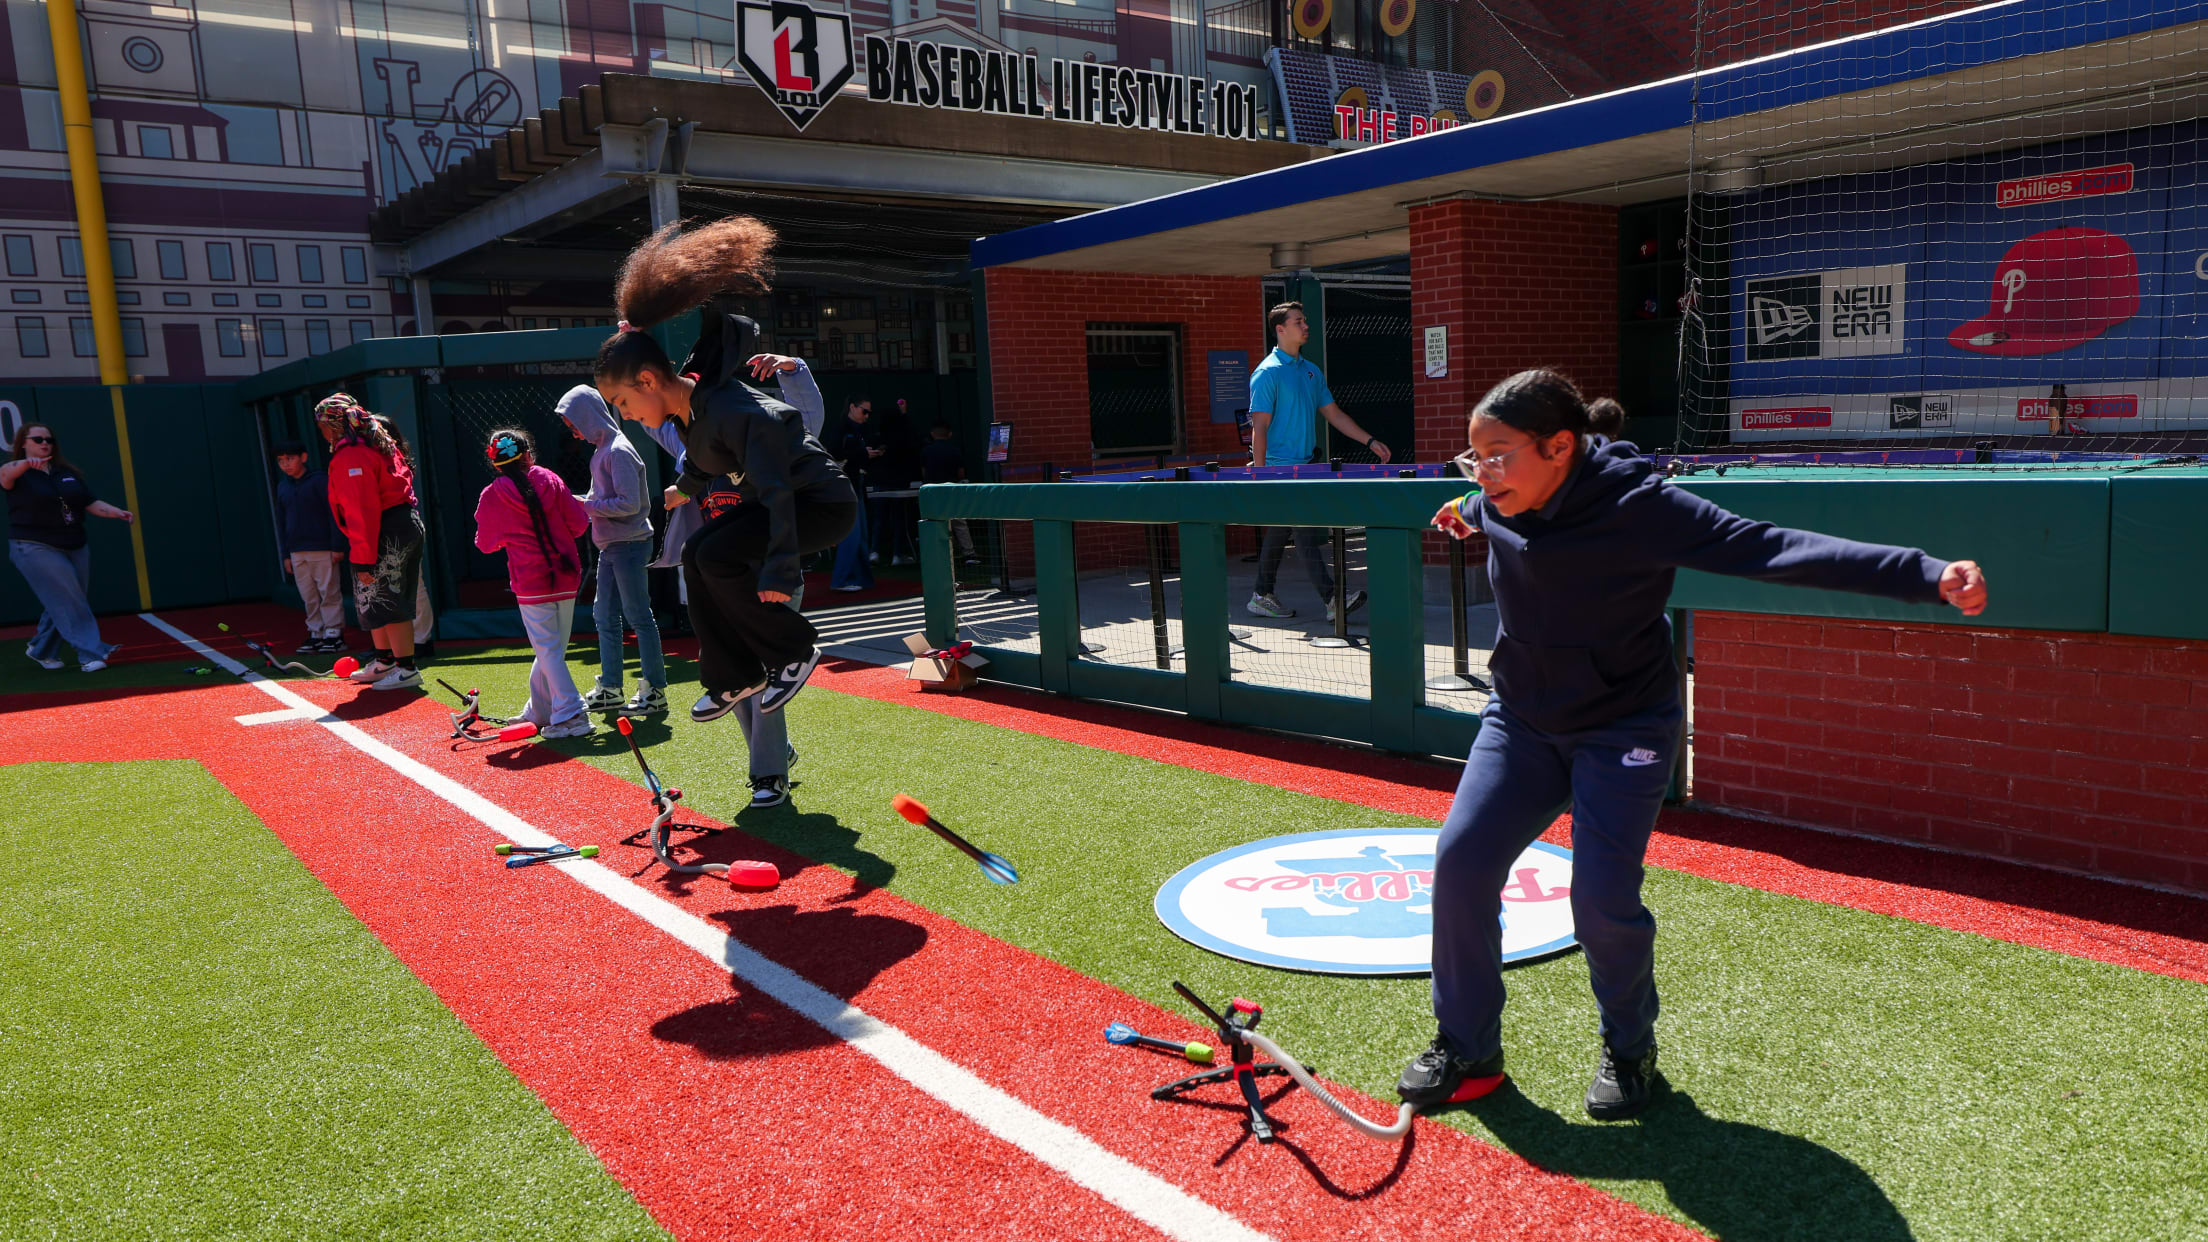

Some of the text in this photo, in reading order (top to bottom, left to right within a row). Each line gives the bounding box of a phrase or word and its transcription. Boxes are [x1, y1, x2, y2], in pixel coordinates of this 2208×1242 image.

[776, 89, 821, 108] 101
[864, 33, 1258, 142] BASEBALL LIFESTYLE 101
[1334, 104, 1398, 144] THE
[2003, 173, 2126, 204] phillies.com
[1833, 285, 1892, 314] NEW
[2002, 268, 2027, 314] P
[1832, 310, 1891, 338] ERA
[1745, 410, 1829, 427] phillies.com
[1924, 412, 1948, 421] ERA
[1925, 402, 1948, 412] NEW
[2022, 401, 2133, 418] phies.com
[1631, 747, 1657, 761] NIKE
